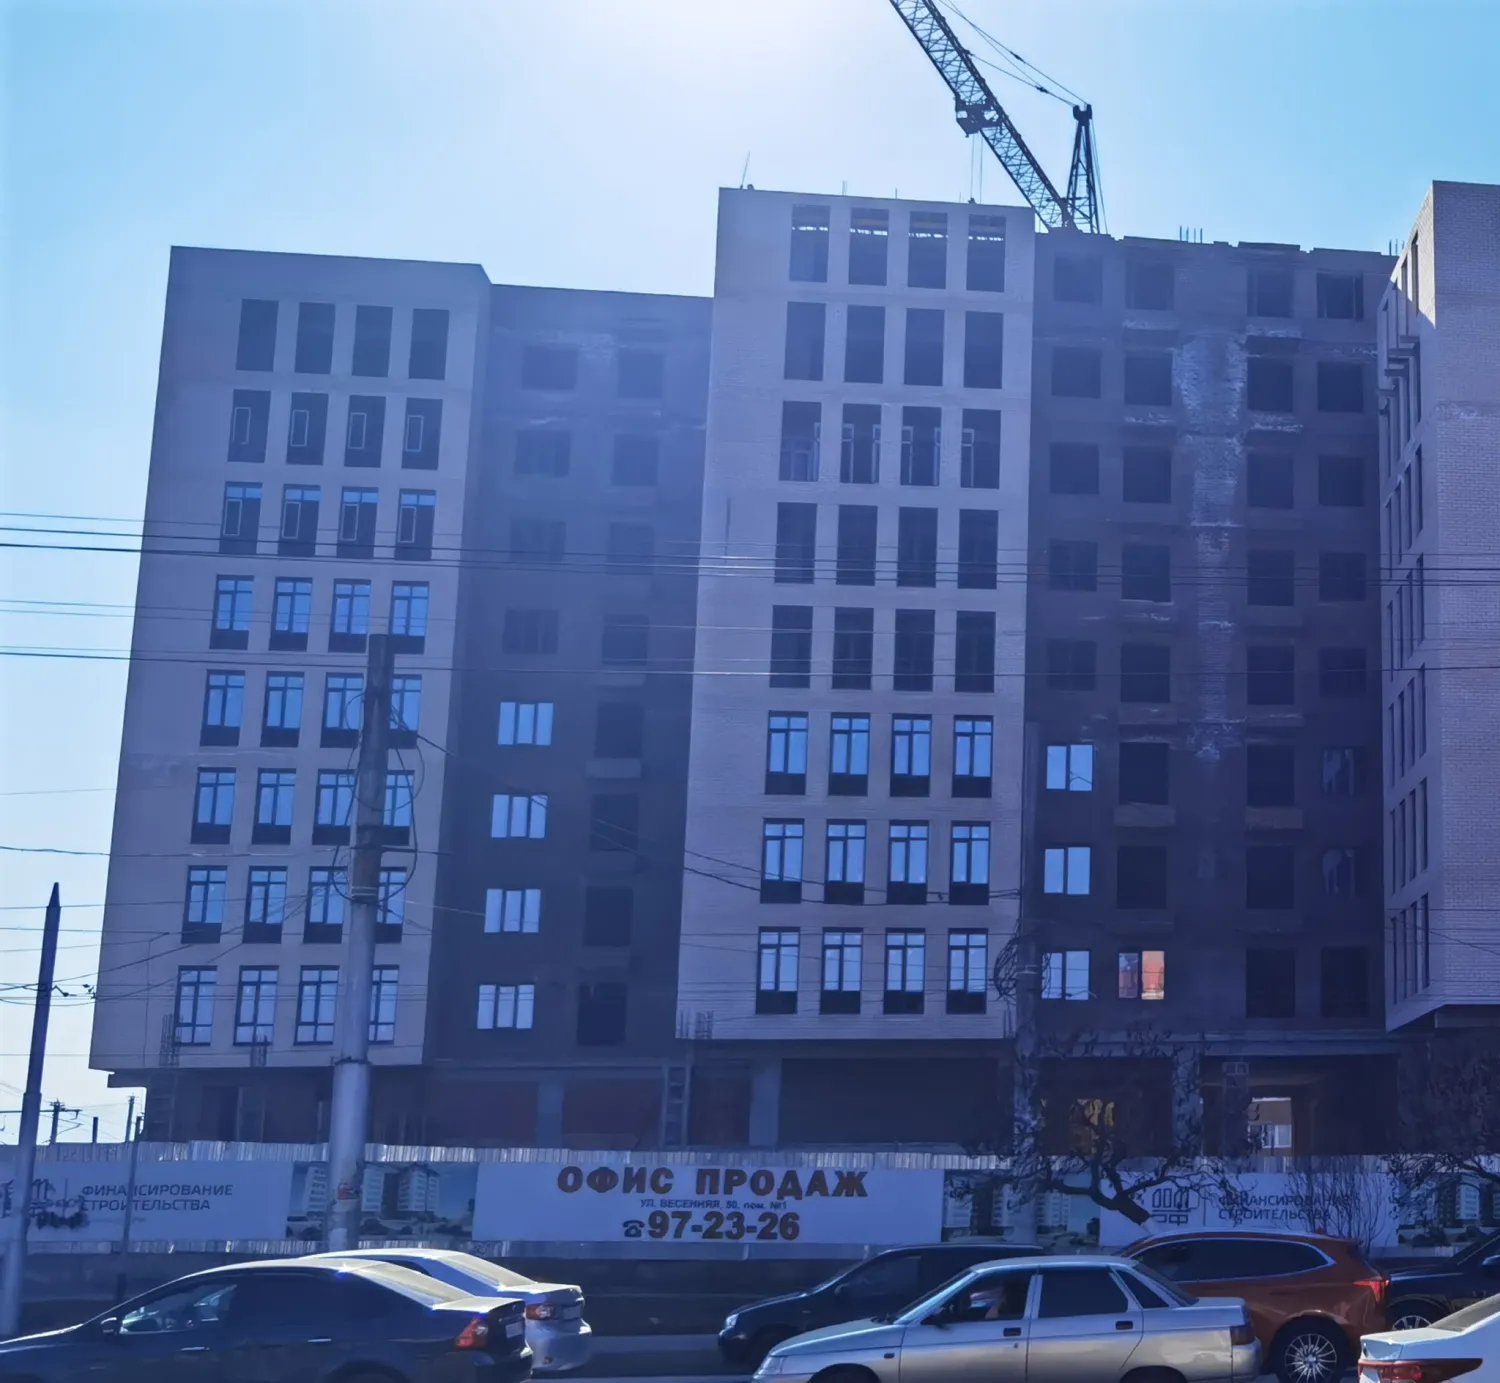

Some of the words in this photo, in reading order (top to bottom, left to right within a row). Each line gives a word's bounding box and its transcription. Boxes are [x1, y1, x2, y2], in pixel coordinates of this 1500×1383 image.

[557, 1166, 674, 1194] ОФИС
[696, 1168, 868, 1200] ПРОДАЖ
[648, 1210, 800, 1240] 97-23-26
